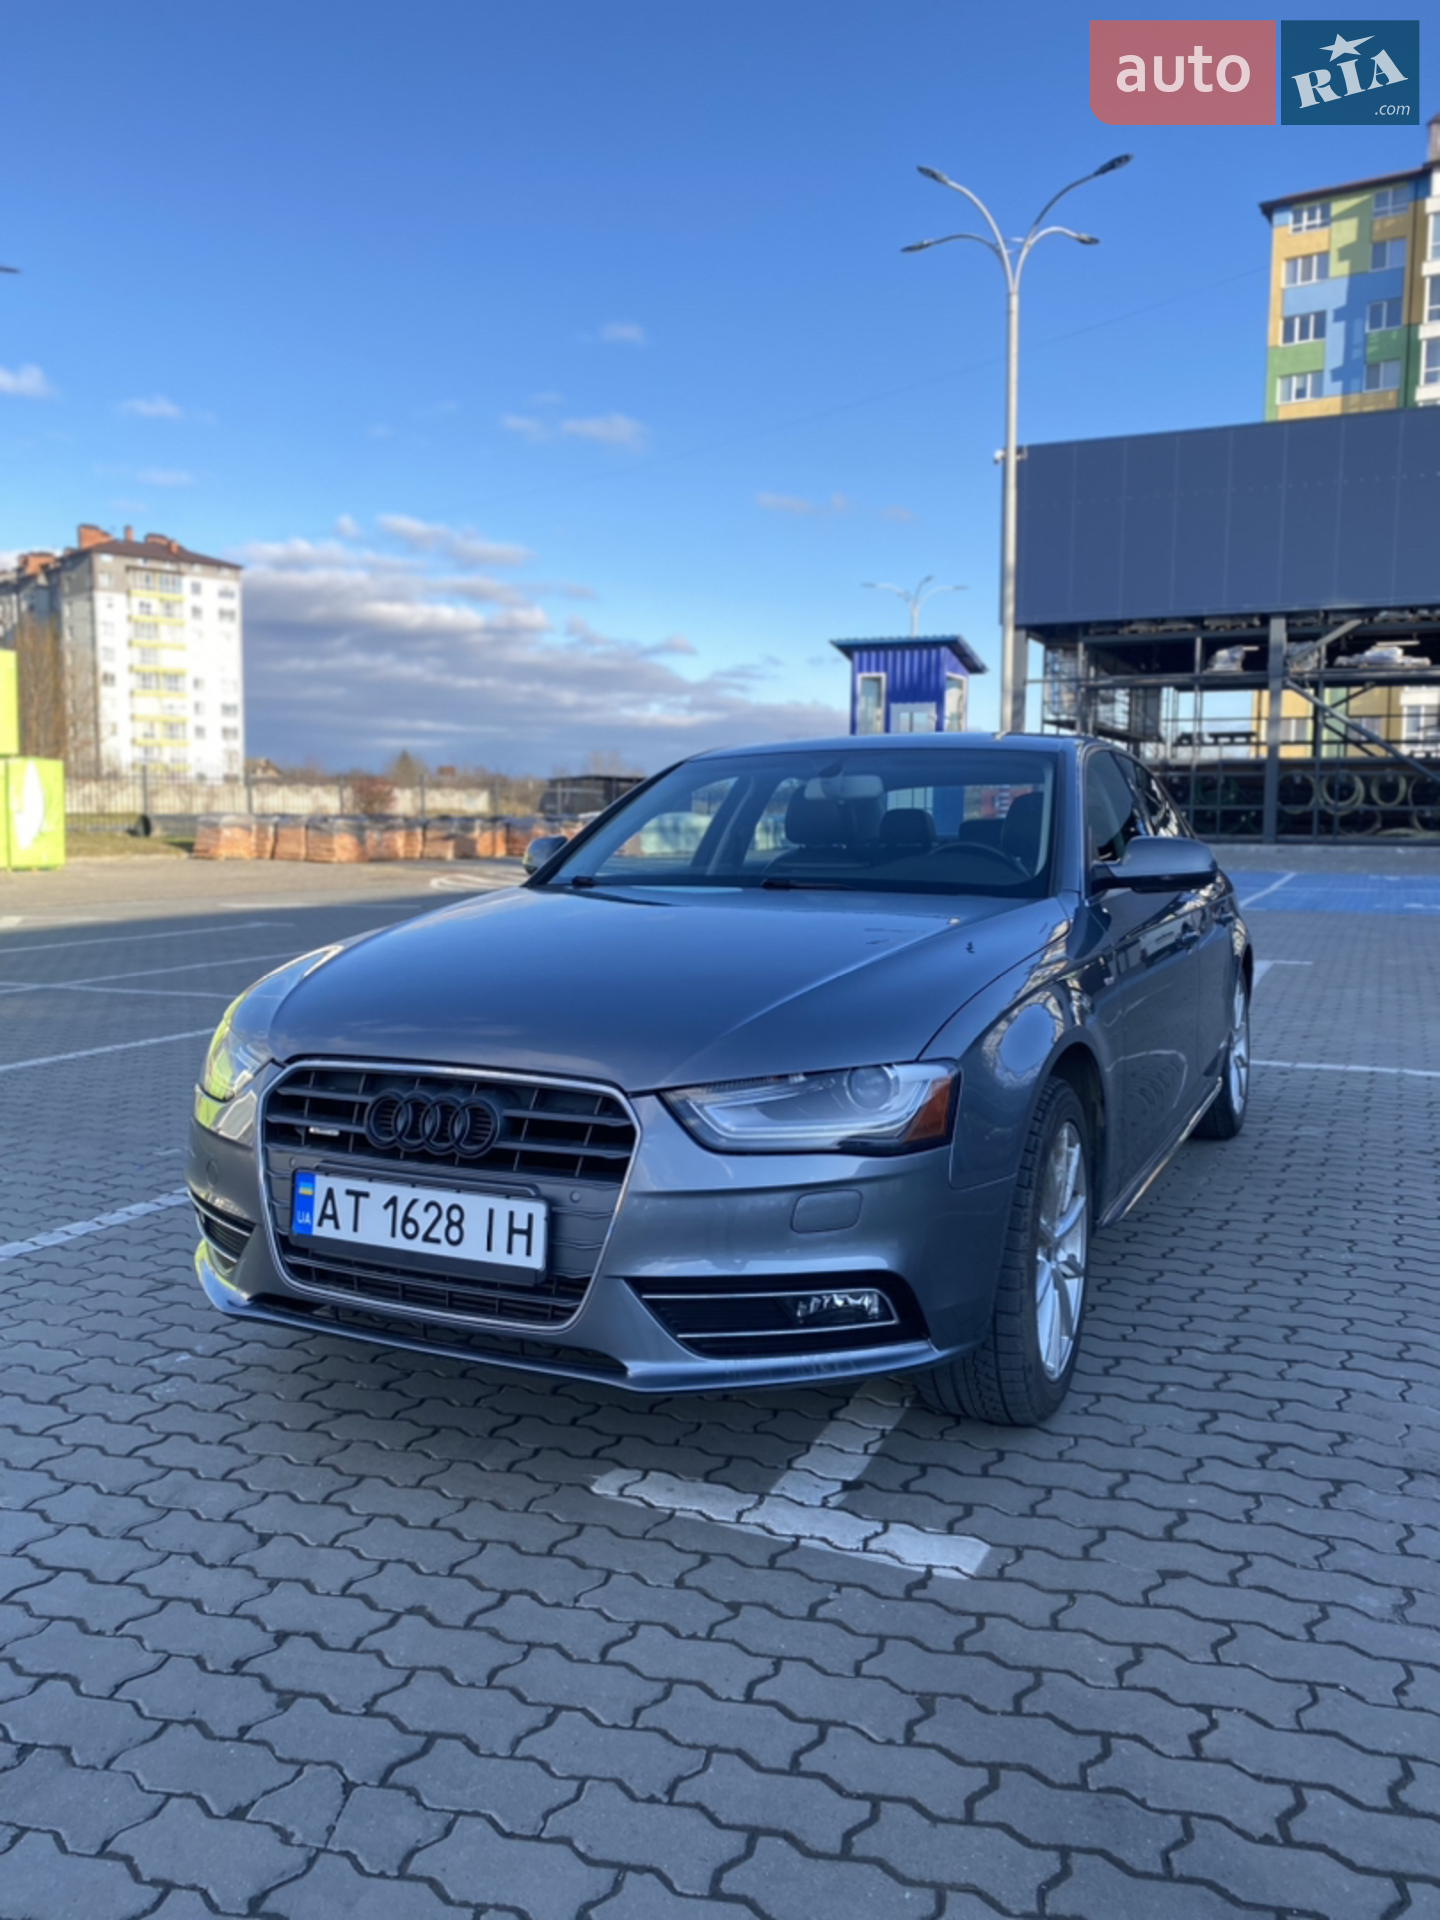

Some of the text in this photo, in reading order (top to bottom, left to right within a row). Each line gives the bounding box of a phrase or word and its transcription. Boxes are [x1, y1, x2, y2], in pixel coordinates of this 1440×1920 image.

[297, 1211, 312, 1226] UA
[317, 1187, 534, 1257] AT 1628 IH
